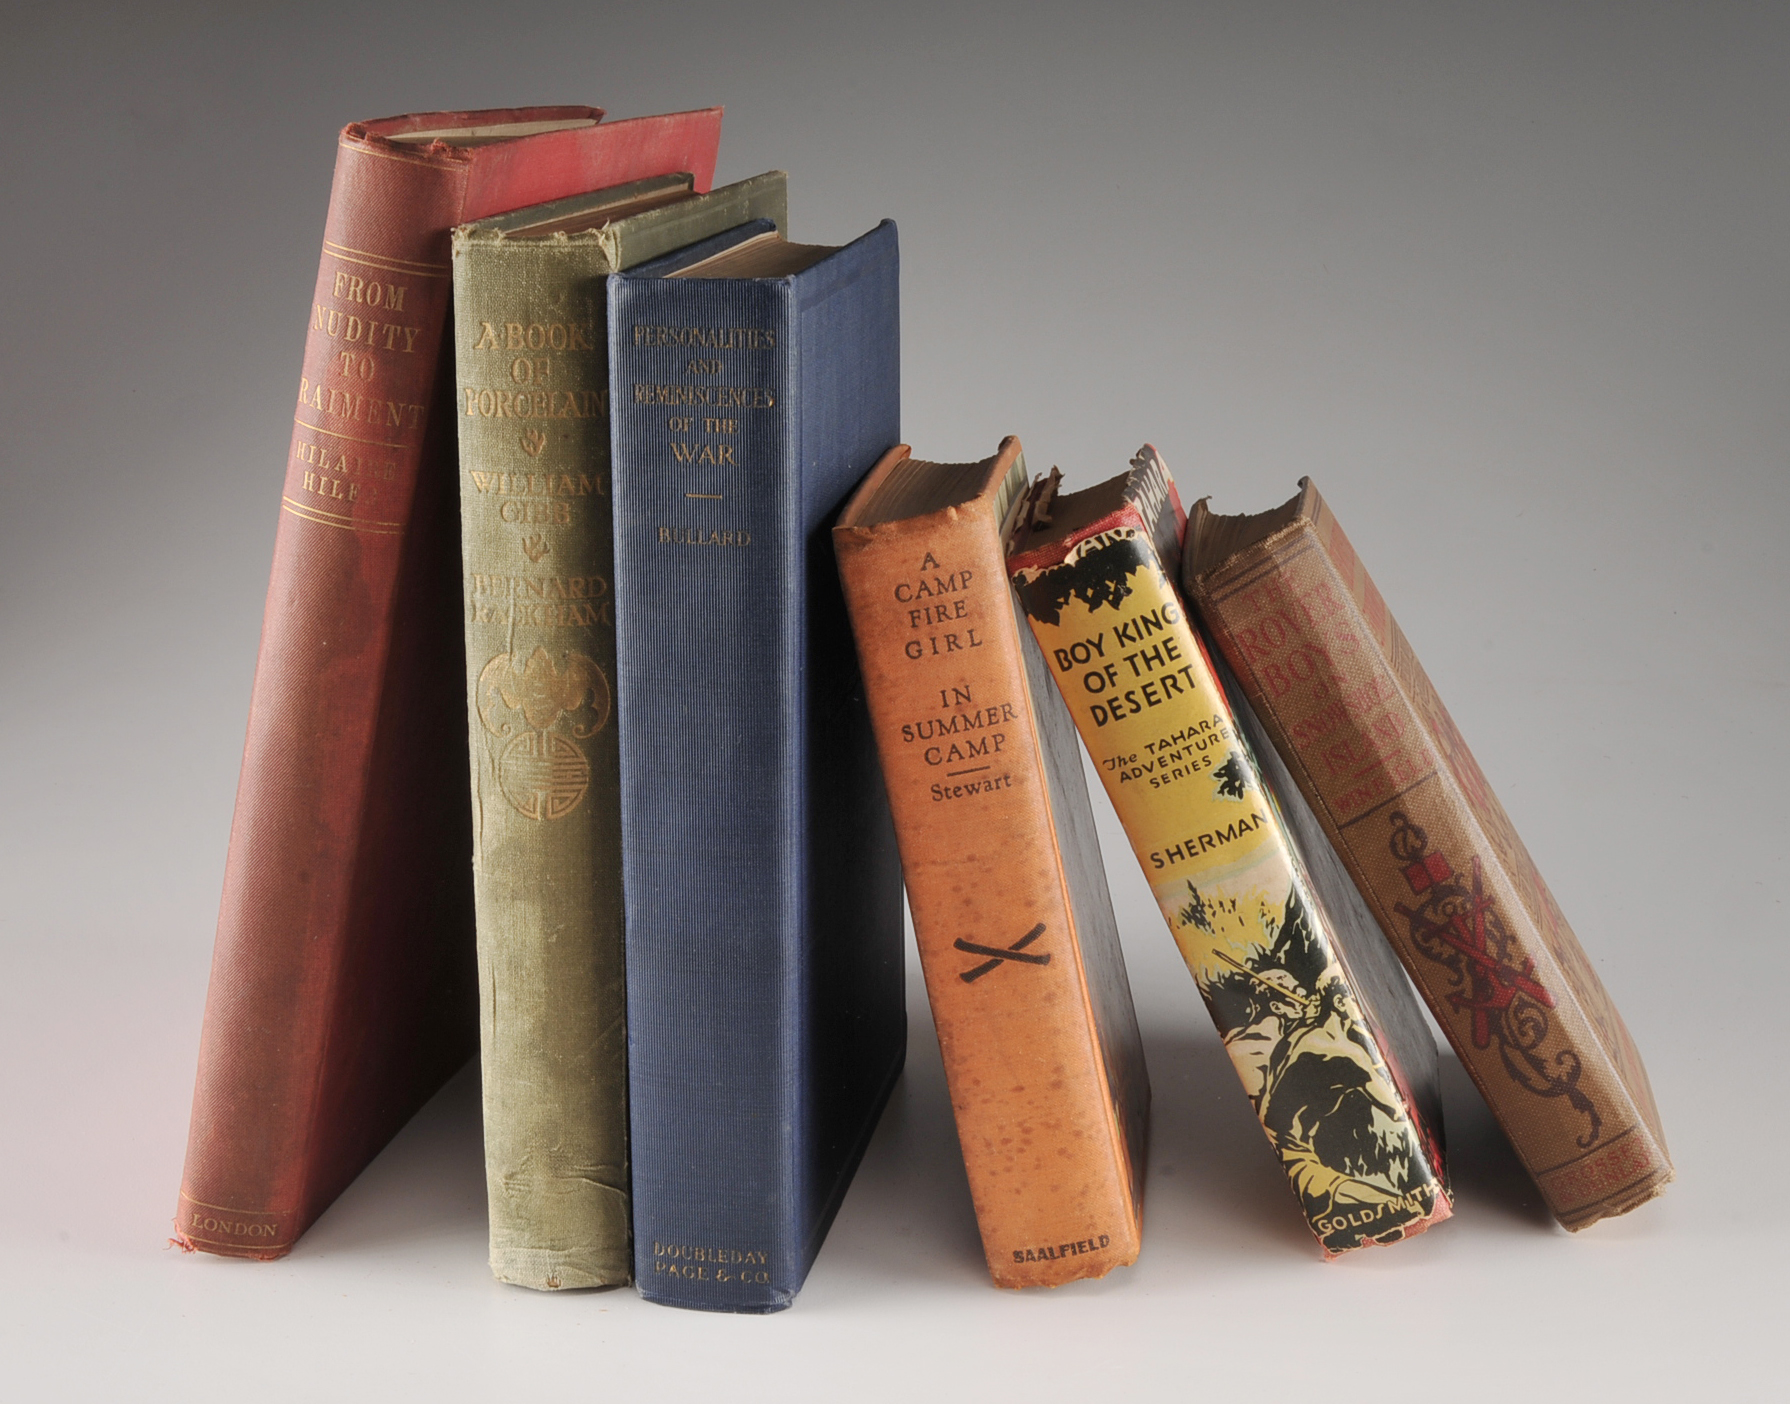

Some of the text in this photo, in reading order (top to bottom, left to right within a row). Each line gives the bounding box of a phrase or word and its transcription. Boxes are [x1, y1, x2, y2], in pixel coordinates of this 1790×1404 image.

[332, 271, 407, 312] FROM
[313, 304, 421, 353] NUDITY
[474, 322, 594, 351] A BOOK
[633, 325, 775, 350] PERSONALITIES
[340, 351, 375, 382] TO
[511, 357, 551, 386] OF
[684, 358, 723, 375] AND
[299, 377, 425, 430] RAIMENT
[464, 388, 608, 418] PORCELAIN
[633, 383, 775, 409] REMINISCENCES
[669, 416, 739, 434] OF THE
[670, 442, 740, 467] WAR
[302, 470, 378, 504] HILE
[469, 470, 605, 496] WILLIAM
[658, 527, 751, 547] BULLARD
[920, 551, 940, 572] A
[894, 570, 973, 603] CAMP
[908, 600, 968, 629] FIRE
[1235, 581, 1344, 664] ROVER
[904, 629, 983, 660] GIRL
[1053, 601, 1180, 673] BOY KING
[1083, 637, 1182, 694] OF THE
[1262, 621, 1361, 699] BOYS
[940, 685, 972, 708] IN
[1089, 664, 1197, 728] DESERT
[902, 702, 1018, 743] SUMMER
[924, 733, 1006, 767] CAMP
[1102, 713, 1224, 772] The TAHARA
[1119, 728, 1230, 784] ADVENTURE
[1149, 754, 1212, 789] SERIES
[931, 773, 1012, 802] Stewart
[1149, 809, 1268, 869] SHERMAN
[1317, 1182, 1437, 1233] GOLDSMITH
[192, 1213, 277, 1237] LONDON
[653, 1240, 770, 1265] DOUBLEDAY
[1012, 1234, 1110, 1263] SAALFIELD
[655, 1260, 709, 1281] PAGE
[715, 1268, 736, 1282] &
